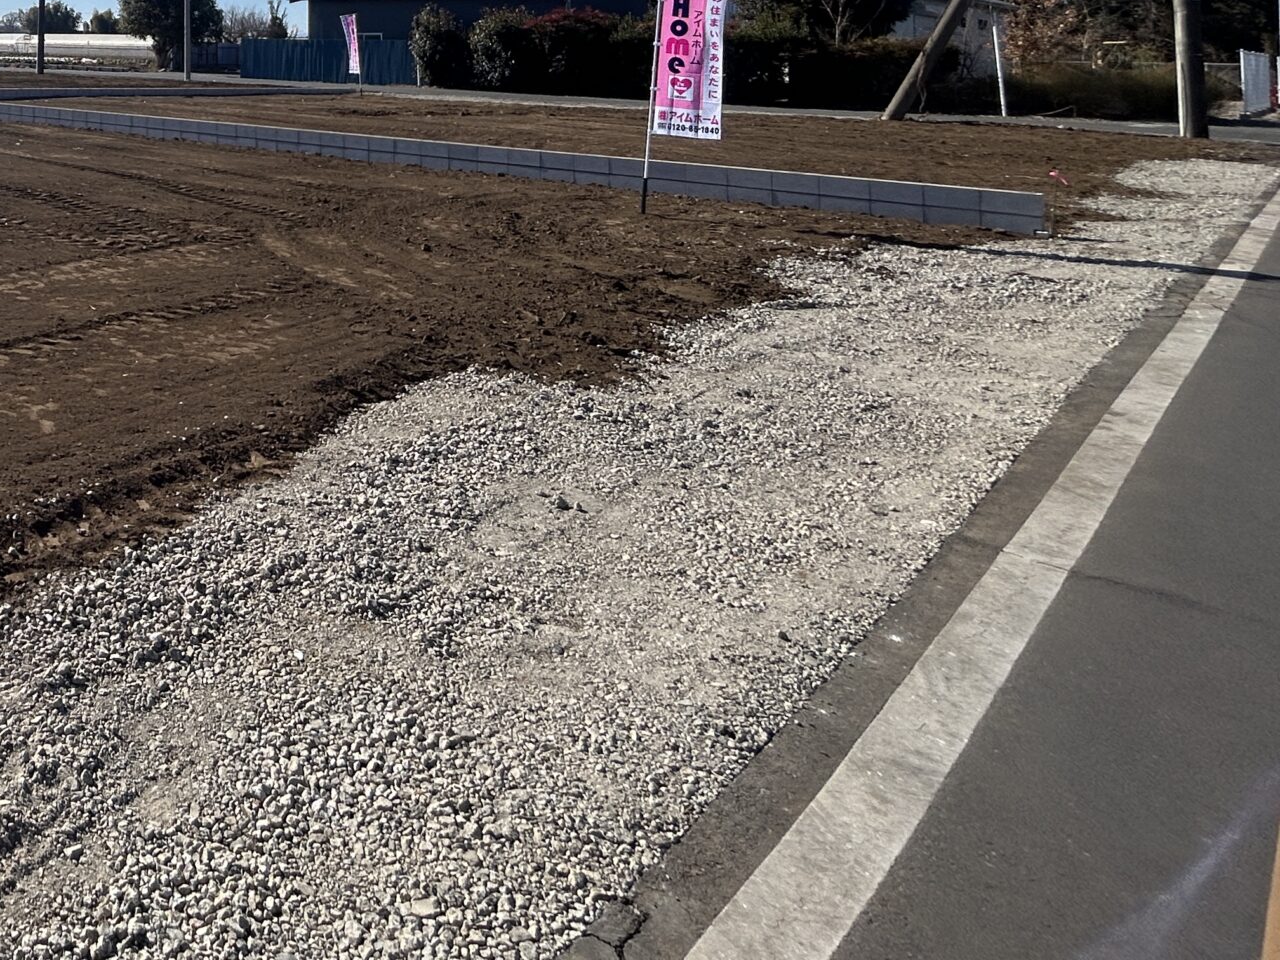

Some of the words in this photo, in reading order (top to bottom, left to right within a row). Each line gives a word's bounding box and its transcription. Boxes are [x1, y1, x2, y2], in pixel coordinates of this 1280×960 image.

[690, 10, 703, 65] アイムホーム
